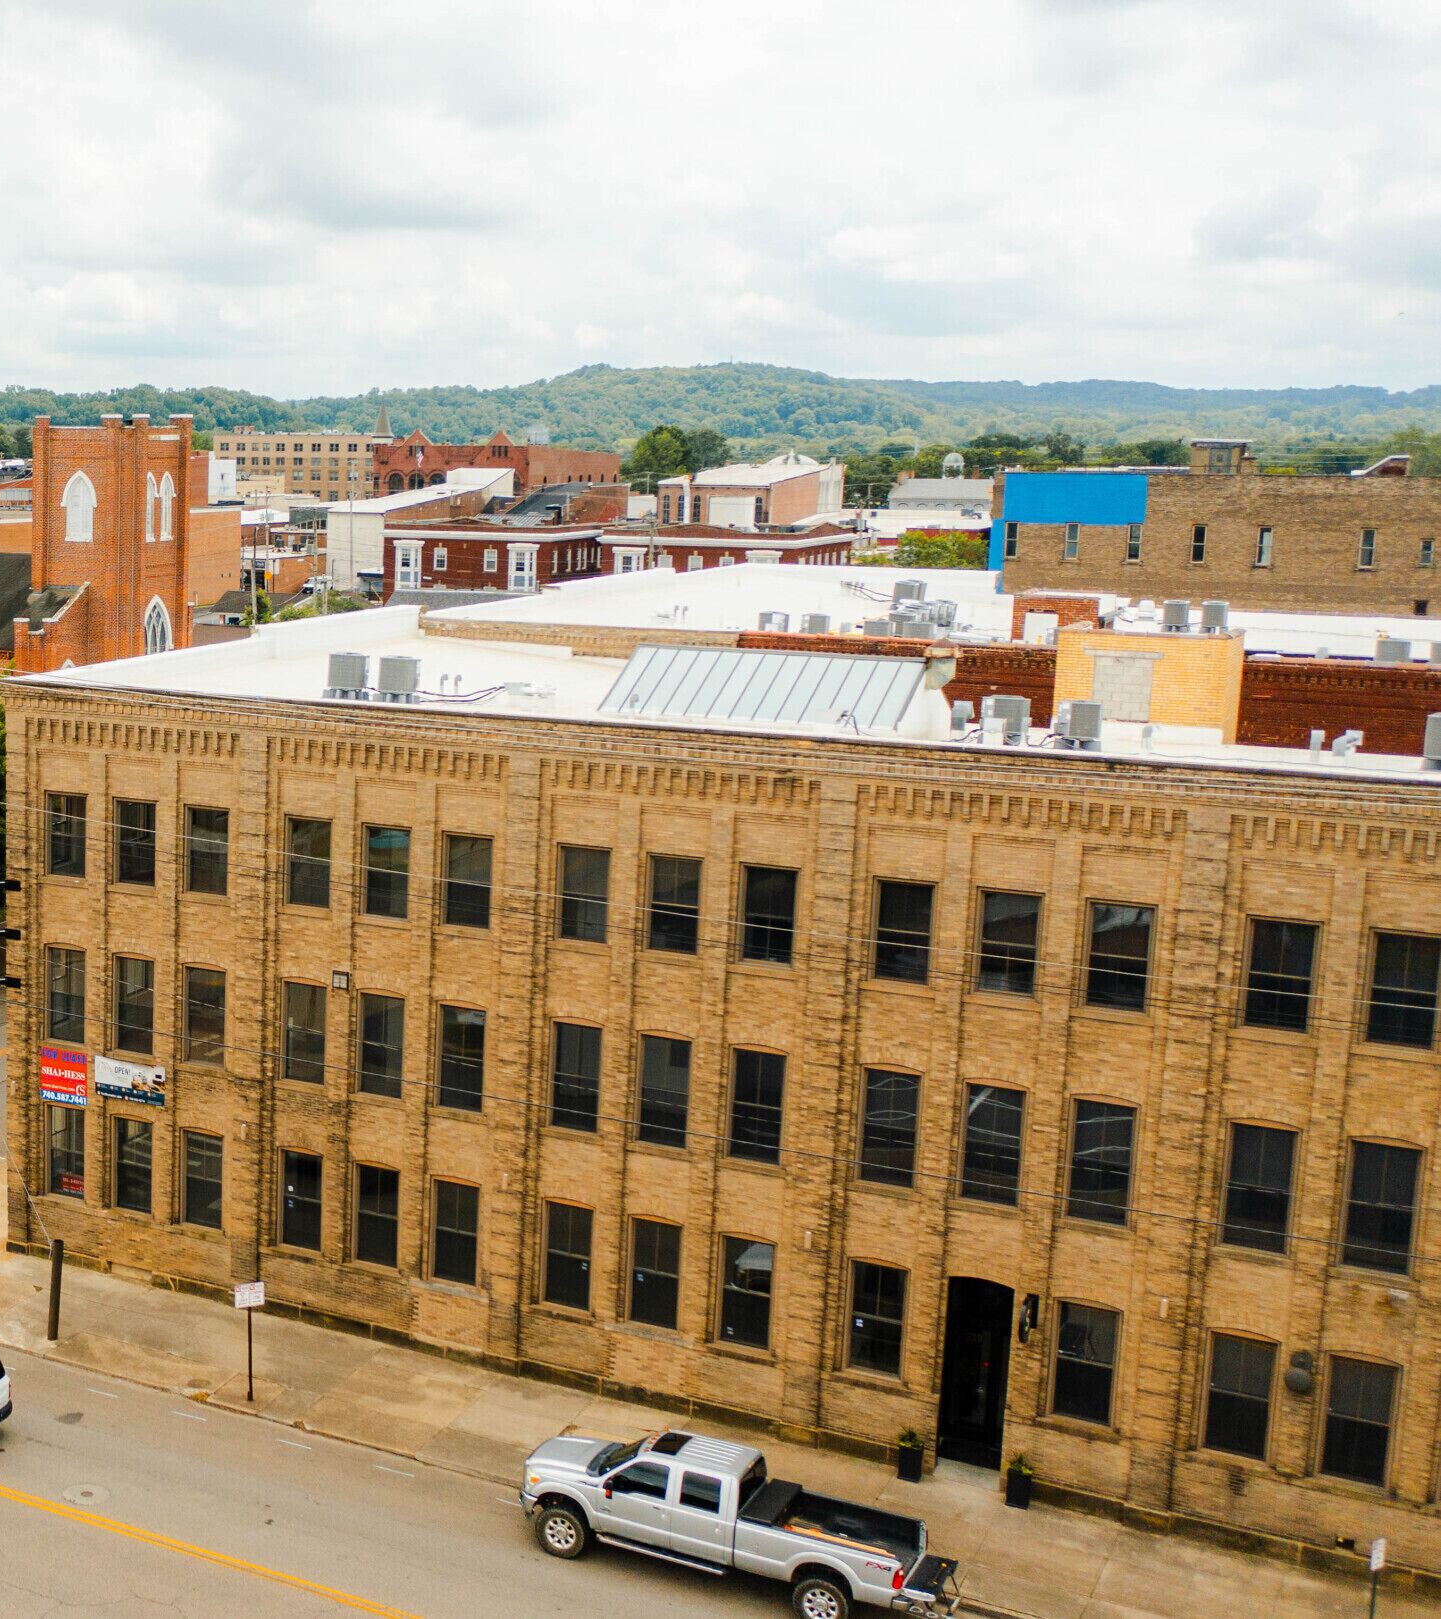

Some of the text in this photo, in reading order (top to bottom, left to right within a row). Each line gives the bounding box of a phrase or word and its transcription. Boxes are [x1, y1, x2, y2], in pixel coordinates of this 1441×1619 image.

[41, 1047, 86, 1065] FOR LEASE
[42, 1090, 87, 1105] 740.587.7441
[865, 1561, 892, 1571] FX4
